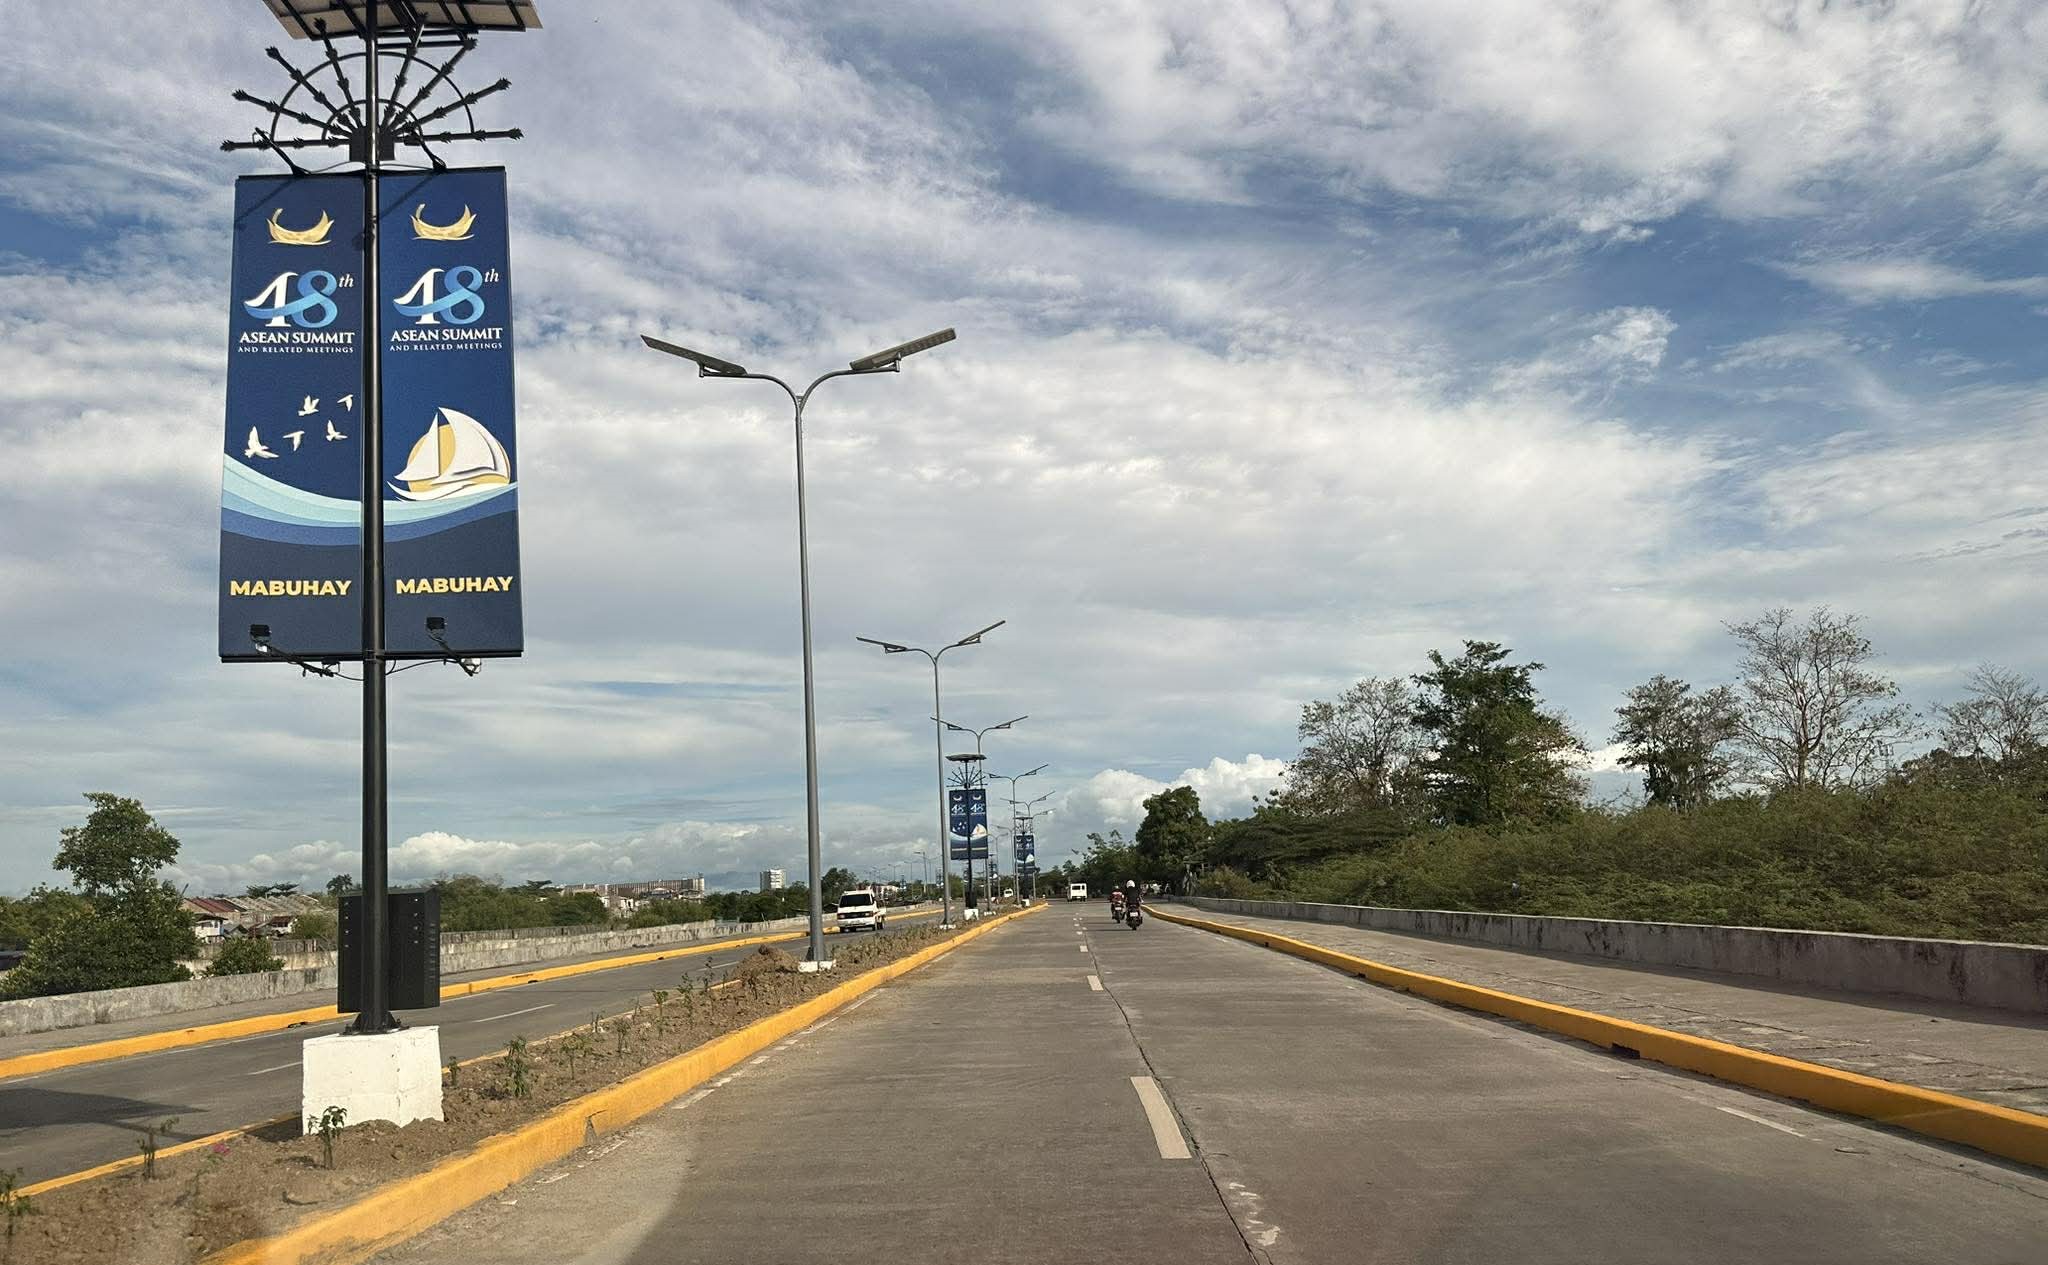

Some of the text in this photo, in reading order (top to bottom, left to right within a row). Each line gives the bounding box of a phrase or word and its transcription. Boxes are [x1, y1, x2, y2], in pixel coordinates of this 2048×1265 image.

[239, 331, 355, 344] ASEAN SUMMIT
[391, 327, 503, 342] ASEAN SUMMIT
[389, 342, 503, 352] AND RELATED MEETINGS
[230, 580, 352, 596] MABUHAY
[396, 576, 513, 594] MABUHAY
